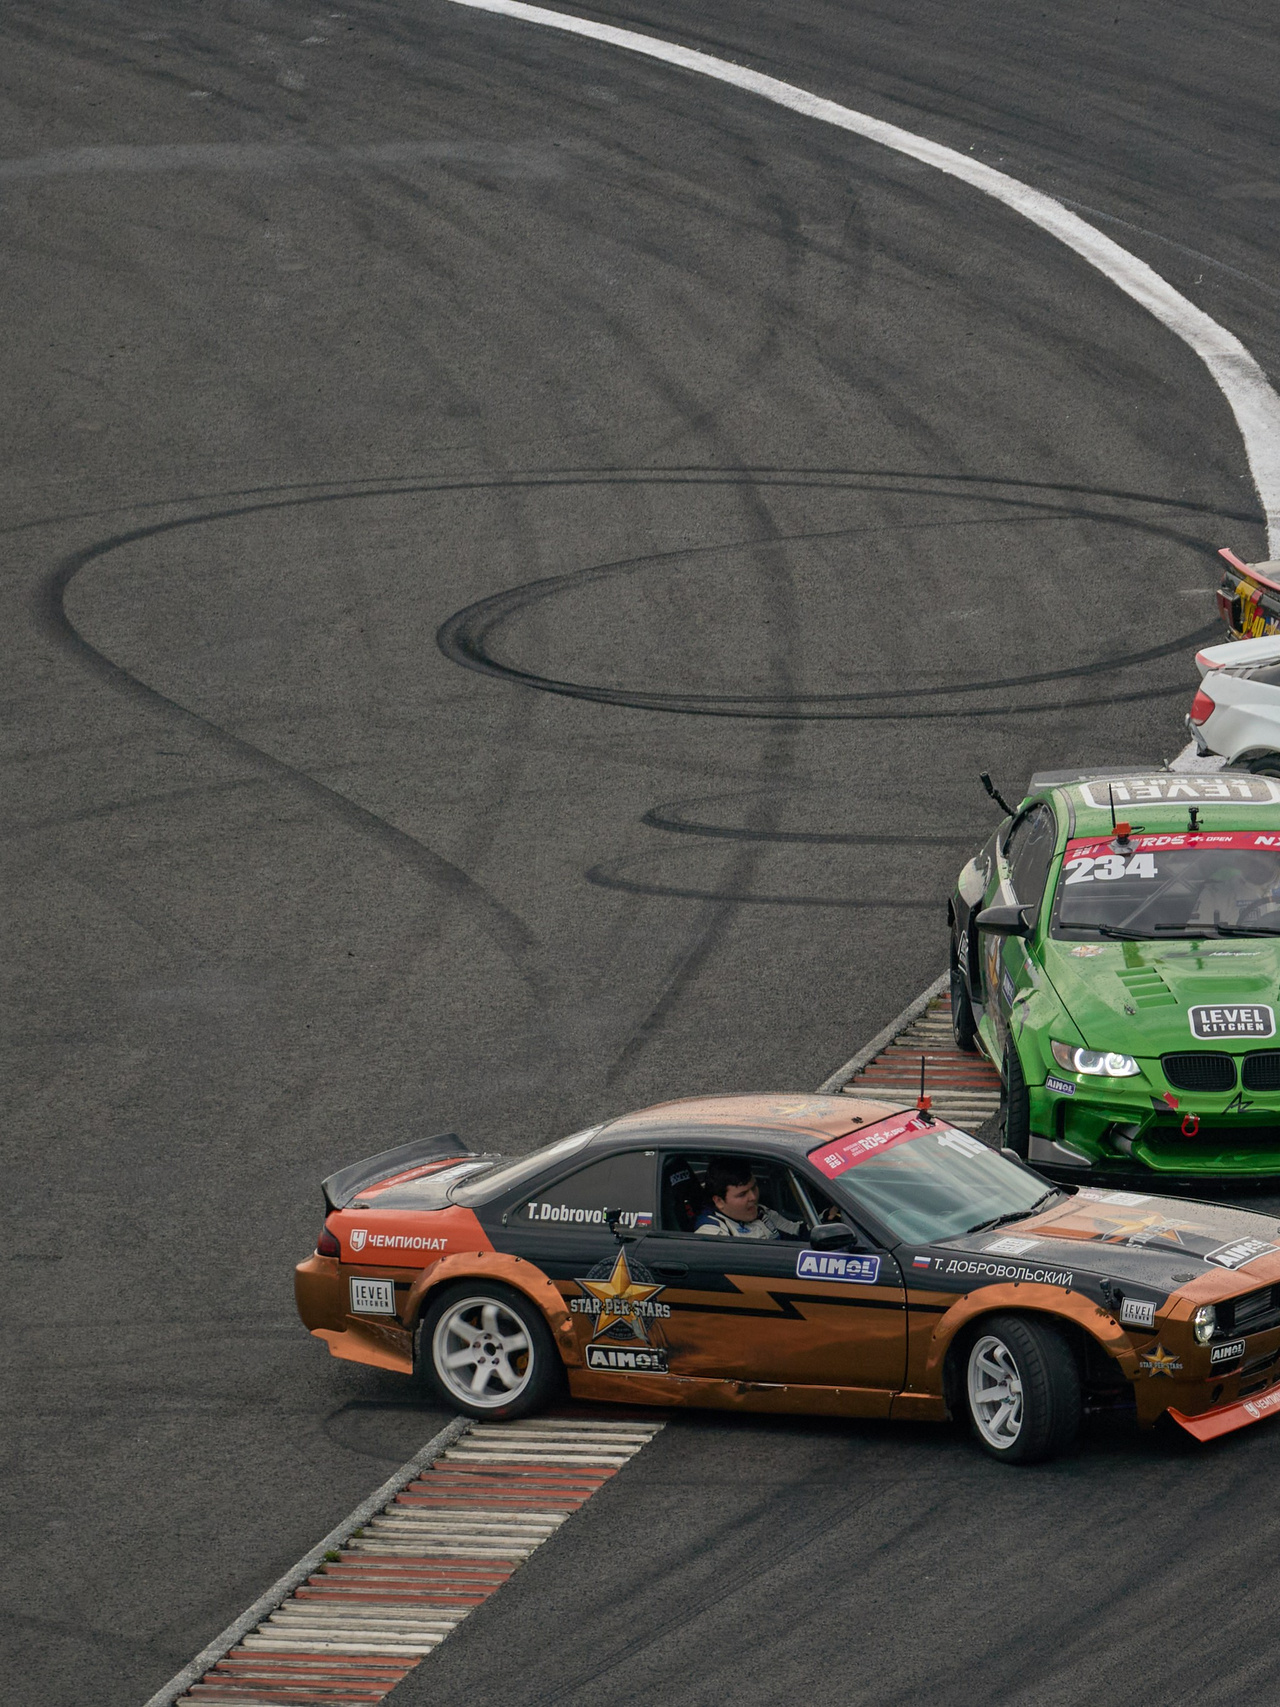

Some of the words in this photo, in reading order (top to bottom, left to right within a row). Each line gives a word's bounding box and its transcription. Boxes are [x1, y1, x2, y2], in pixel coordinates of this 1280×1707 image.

[1109, 784, 1252, 800] LEVEL
[1140, 836, 1186, 847] RDS
[1064, 853, 1158, 885] 234
[1200, 1009, 1263, 1024] LEVEL
[1202, 1022, 1264, 1032] KITCHEN
[1047, 1077, 1074, 1092] AIMOL
[858, 1133, 887, 1150] RDS
[368, 1234, 448, 1250] ЧЕМПИОНАТ
[1216, 1239, 1269, 1267] AIMOL
[799, 1256, 874, 1277] AIMOL
[934, 1258, 943, 1270] Т.
[946, 1260, 1074, 1286] ДОБРОВОЛЬСКИЙ
[356, 1299, 389, 1308] KITCHEN
[571, 1298, 602, 1315] STAR
[605, 1299, 629, 1315] PER
[632, 1301, 671, 1318] STARS
[1213, 1343, 1243, 1360] AIMOL
